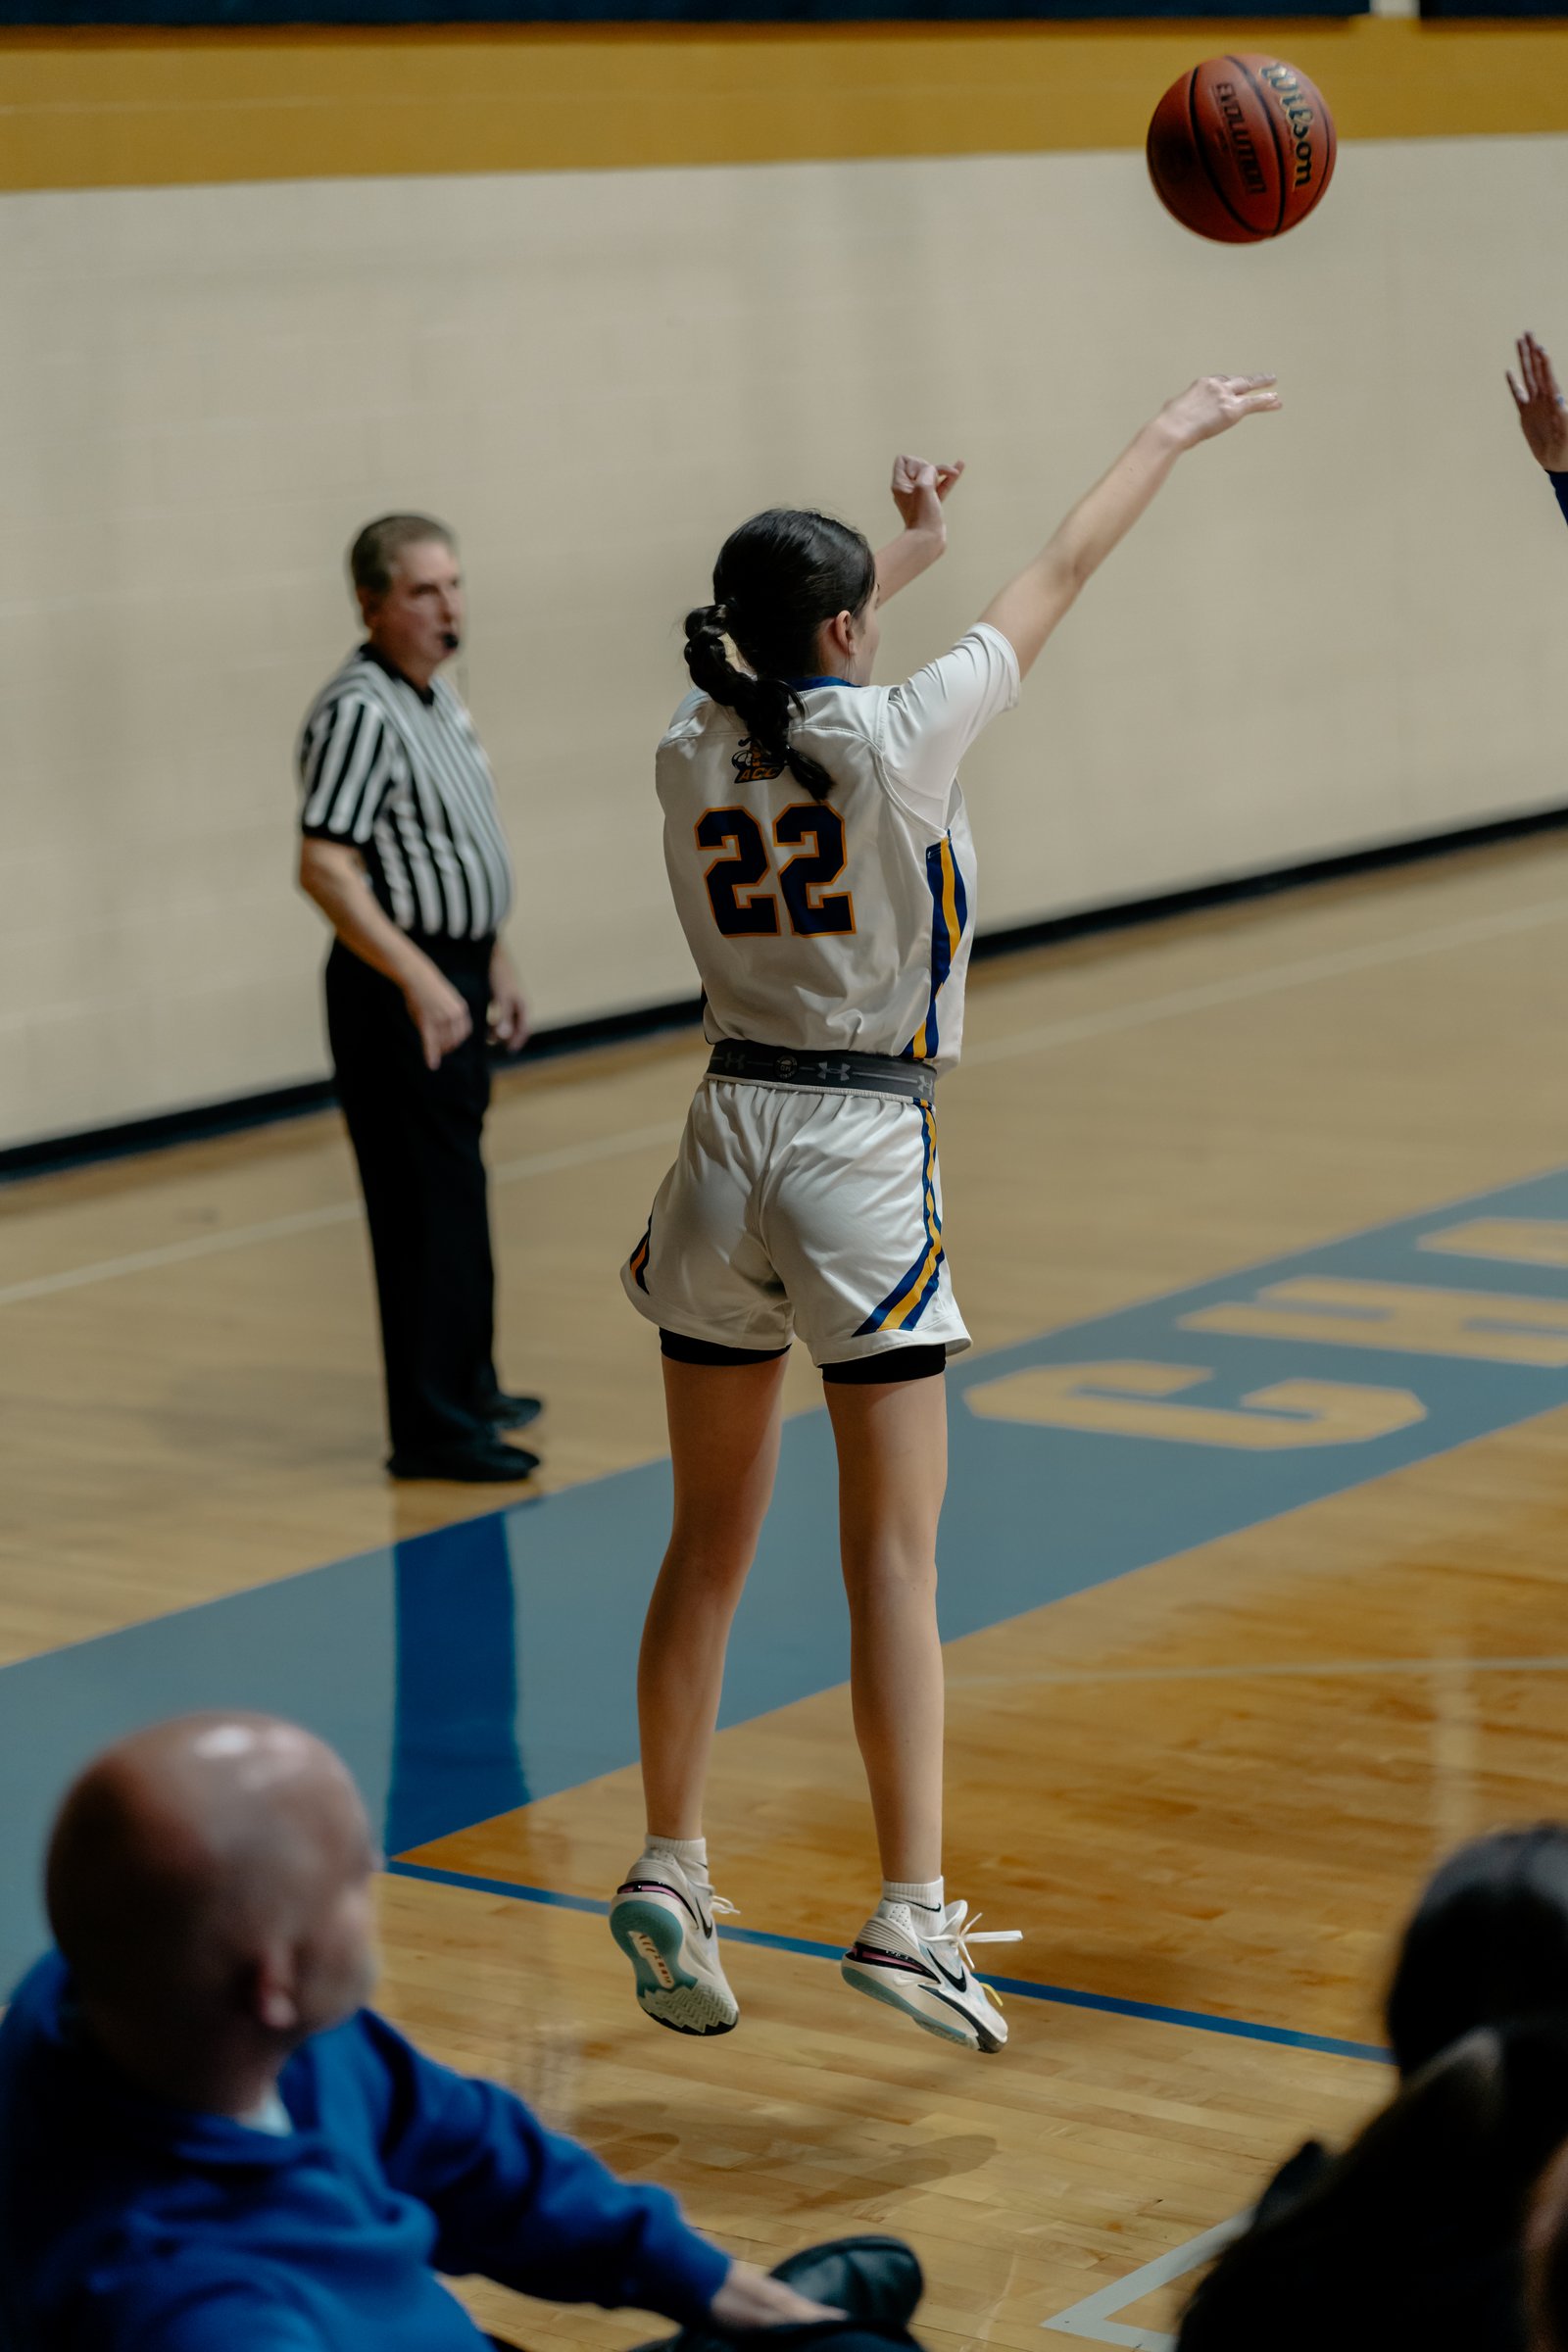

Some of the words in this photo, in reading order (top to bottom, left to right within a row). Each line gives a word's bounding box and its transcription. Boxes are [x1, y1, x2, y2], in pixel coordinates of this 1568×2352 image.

[1215, 82, 1266, 194] EVOLUTION
[1258, 61, 1313, 188] Wilson
[694, 801, 857, 939] 22
